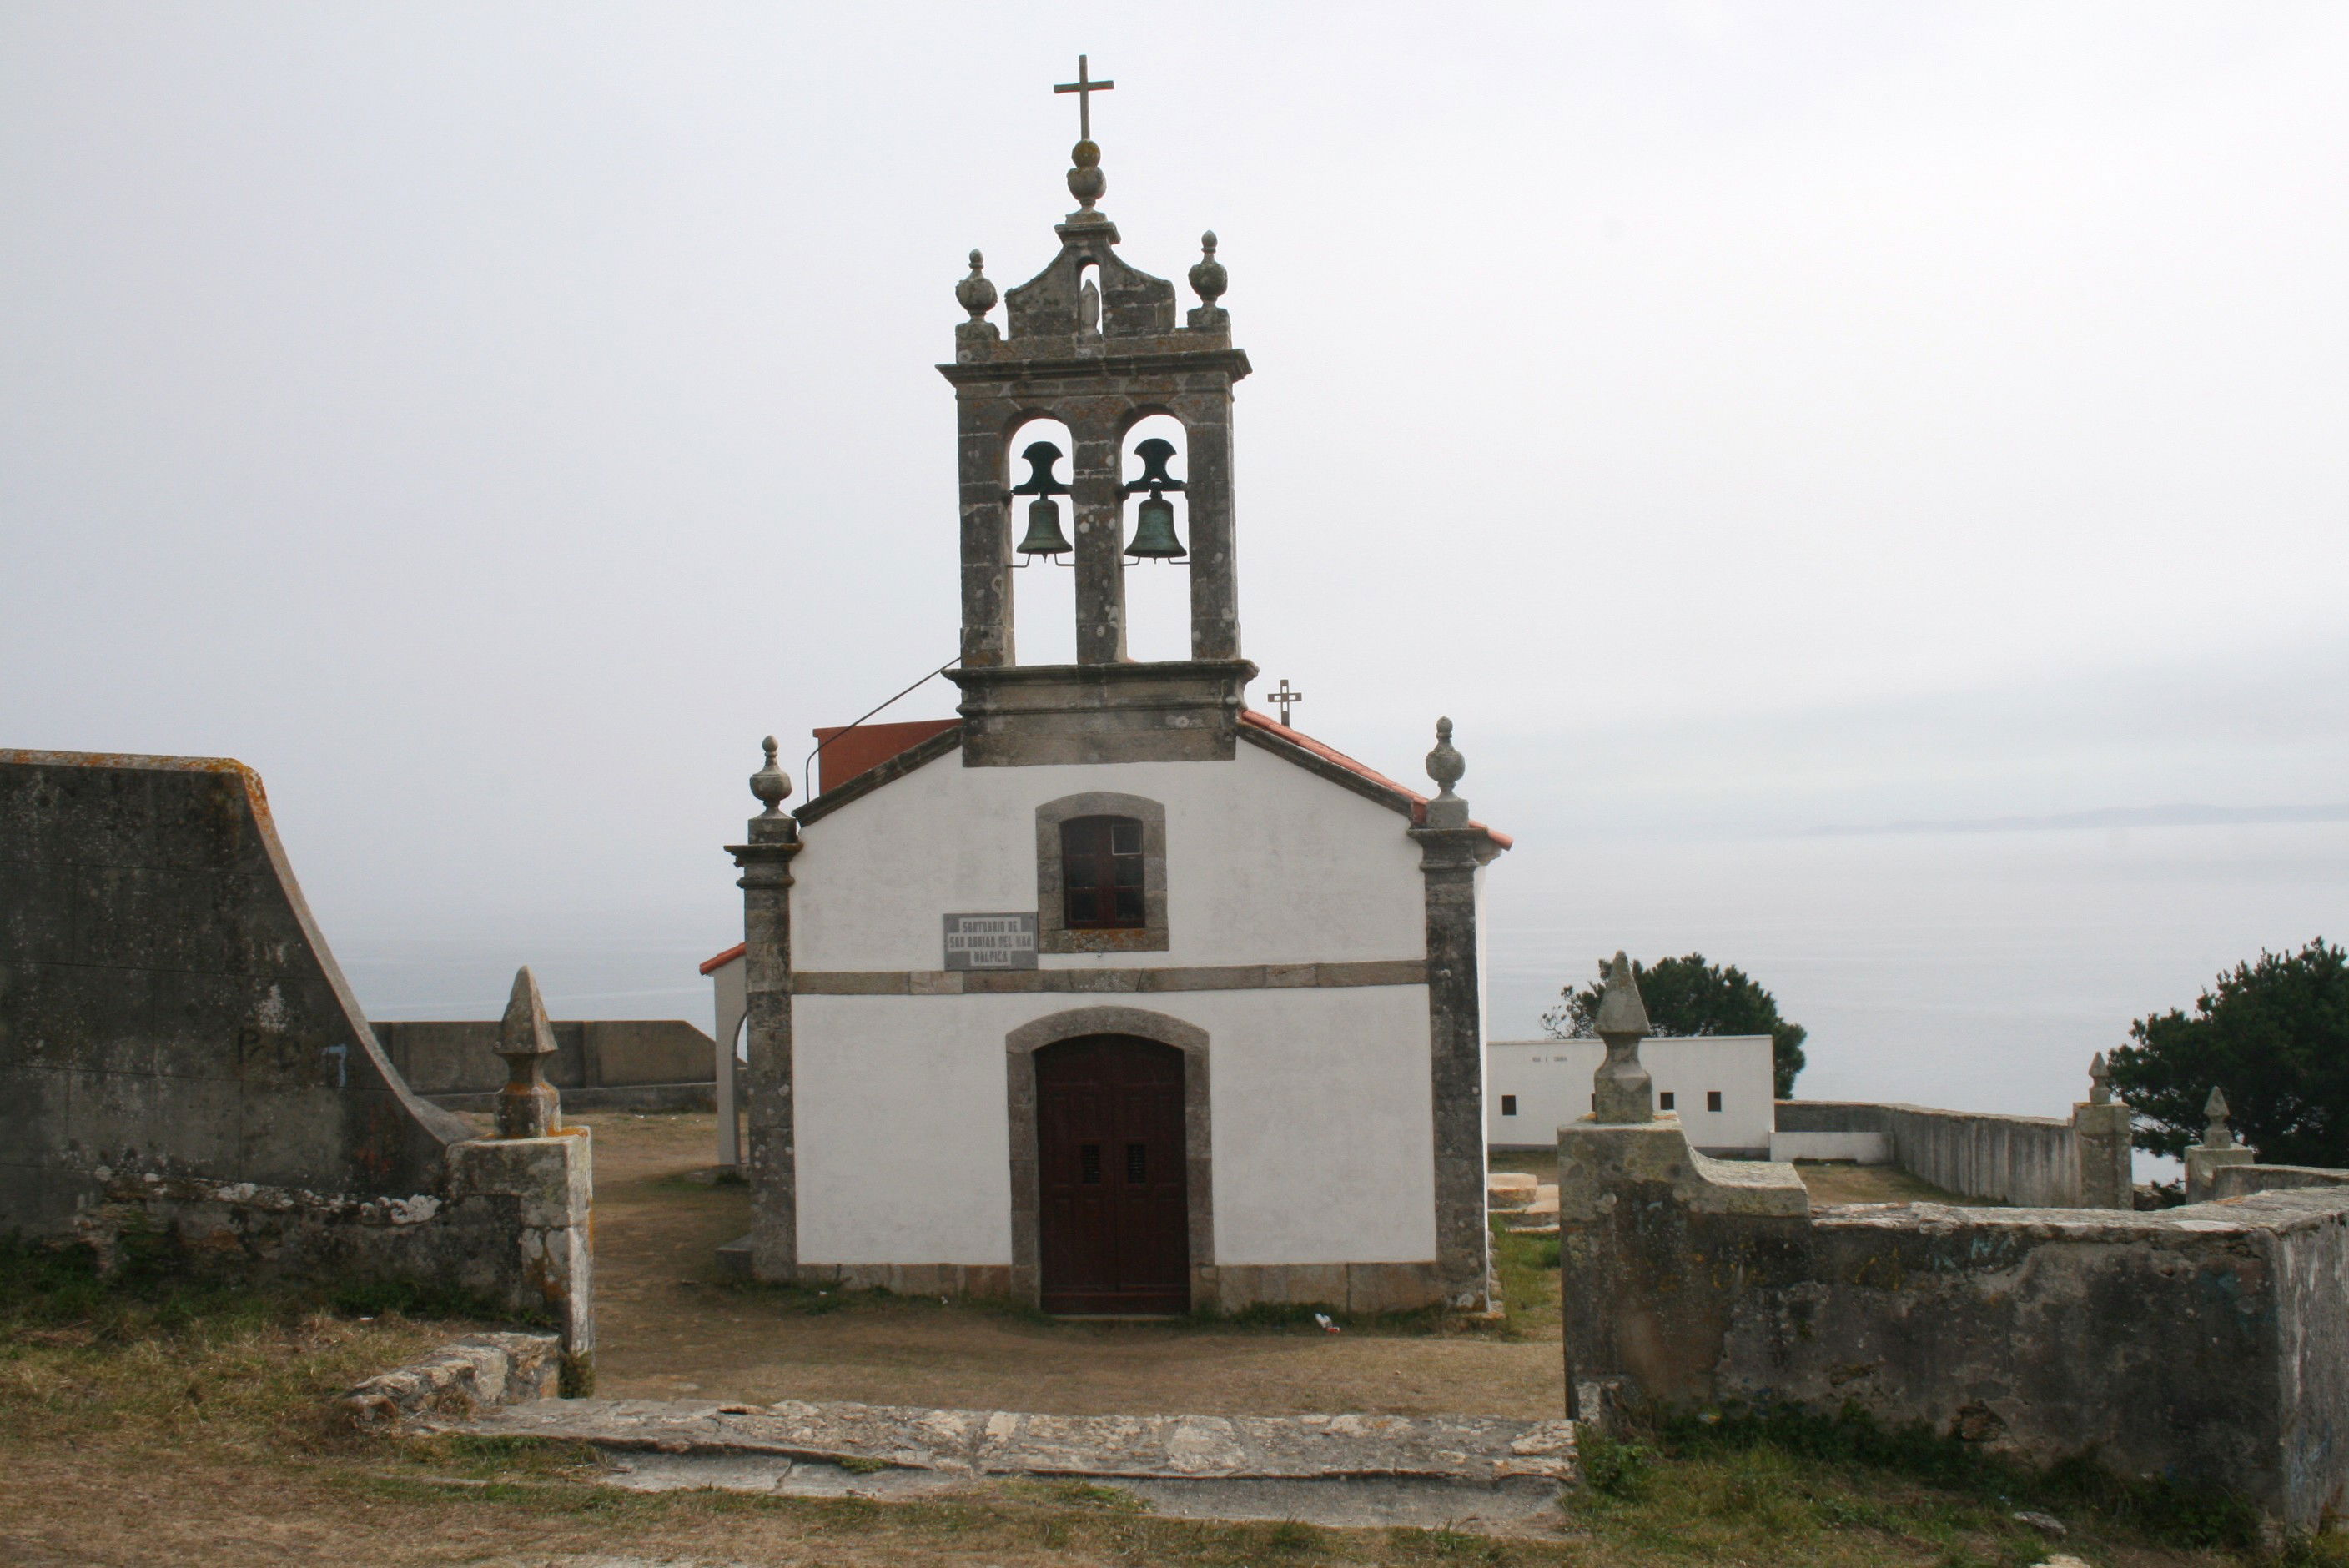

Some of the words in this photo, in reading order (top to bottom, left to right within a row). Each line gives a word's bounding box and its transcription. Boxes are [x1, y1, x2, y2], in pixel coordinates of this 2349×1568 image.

[963, 920, 1005, 932] SANTUARIO
[1008, 920, 1019, 932] DE
[949, 936, 965, 948] SAN
[998, 936, 1013, 947] DEL
[1015, 935, 1032, 947] MAR
[973, 950, 1008, 962] MALPICA
